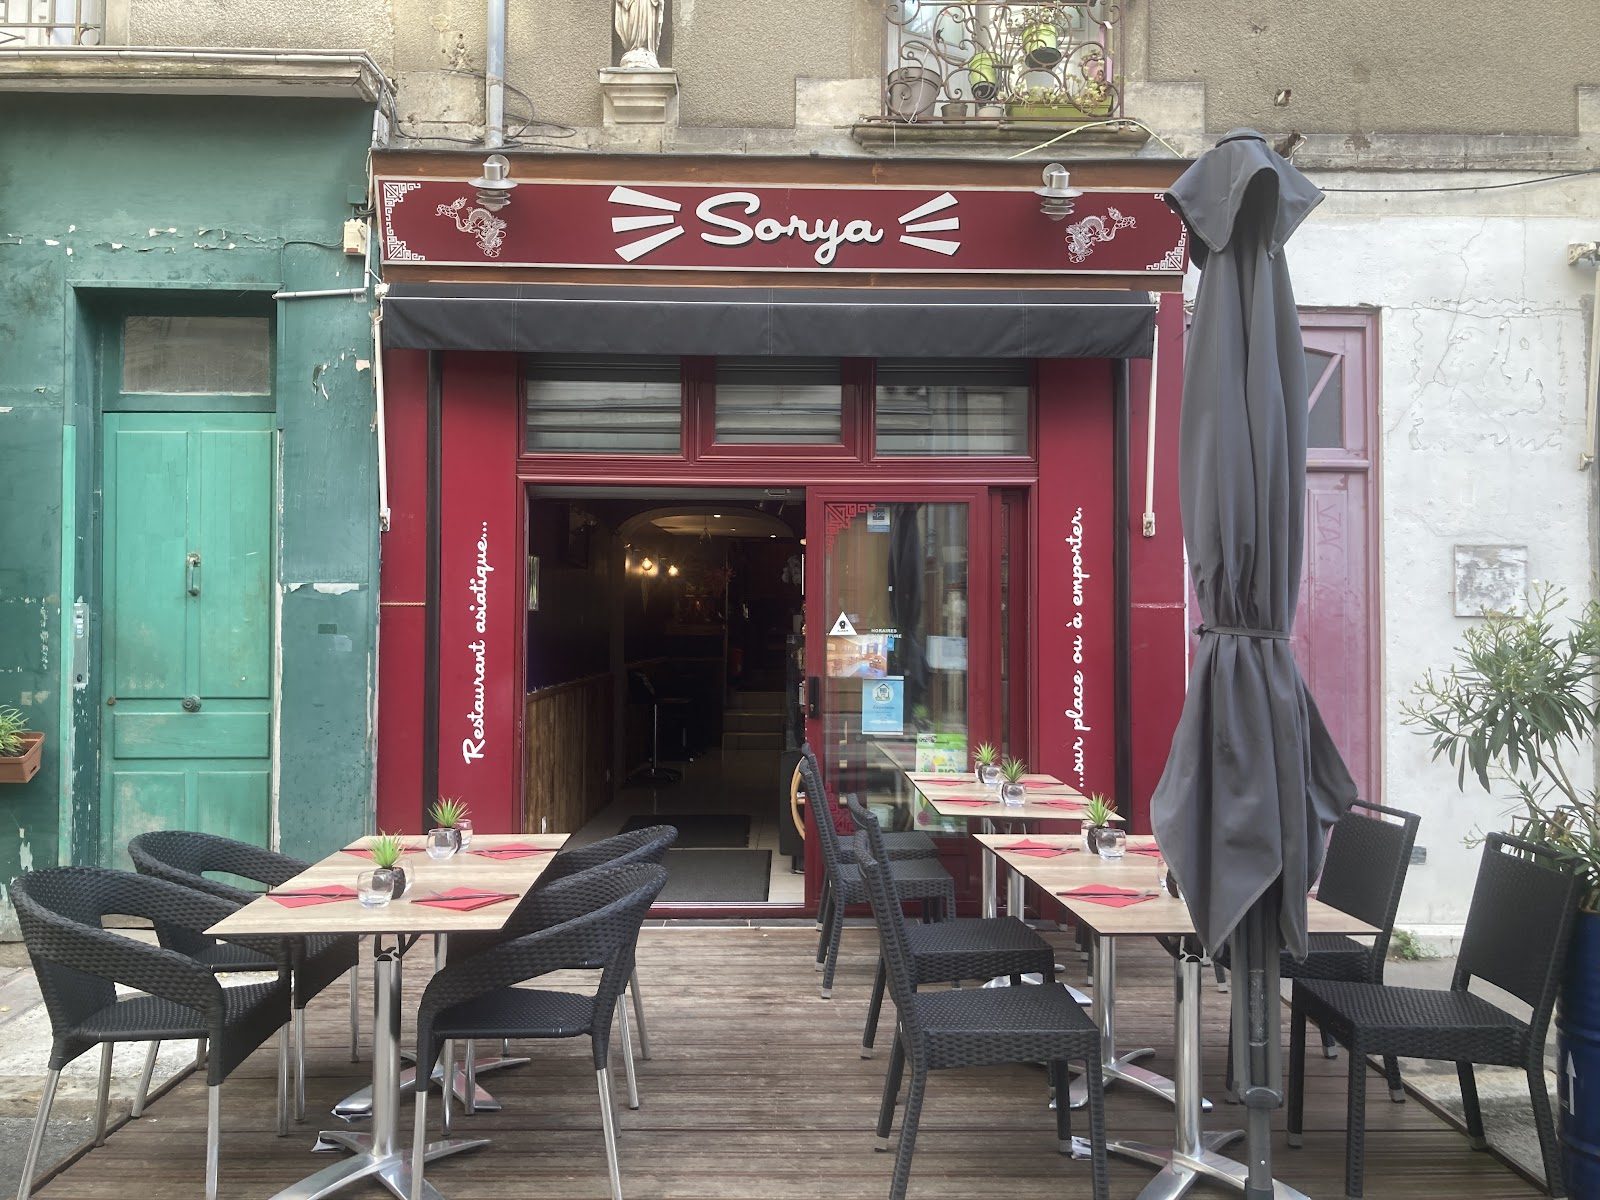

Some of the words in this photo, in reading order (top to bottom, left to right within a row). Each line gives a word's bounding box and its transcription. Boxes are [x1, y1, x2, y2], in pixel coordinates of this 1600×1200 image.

[695, 191, 884, 265] Sorya
[468, 521, 495, 634] asiatique...
[1065, 506, 1091, 607] emporter.
[1065, 611, 1083, 629] à
[1072, 634, 1084, 665] ou
[462, 639, 486, 765] Restaurant
[1065, 669, 1091, 732] place
[1072, 736, 1085, 788] ...sur
